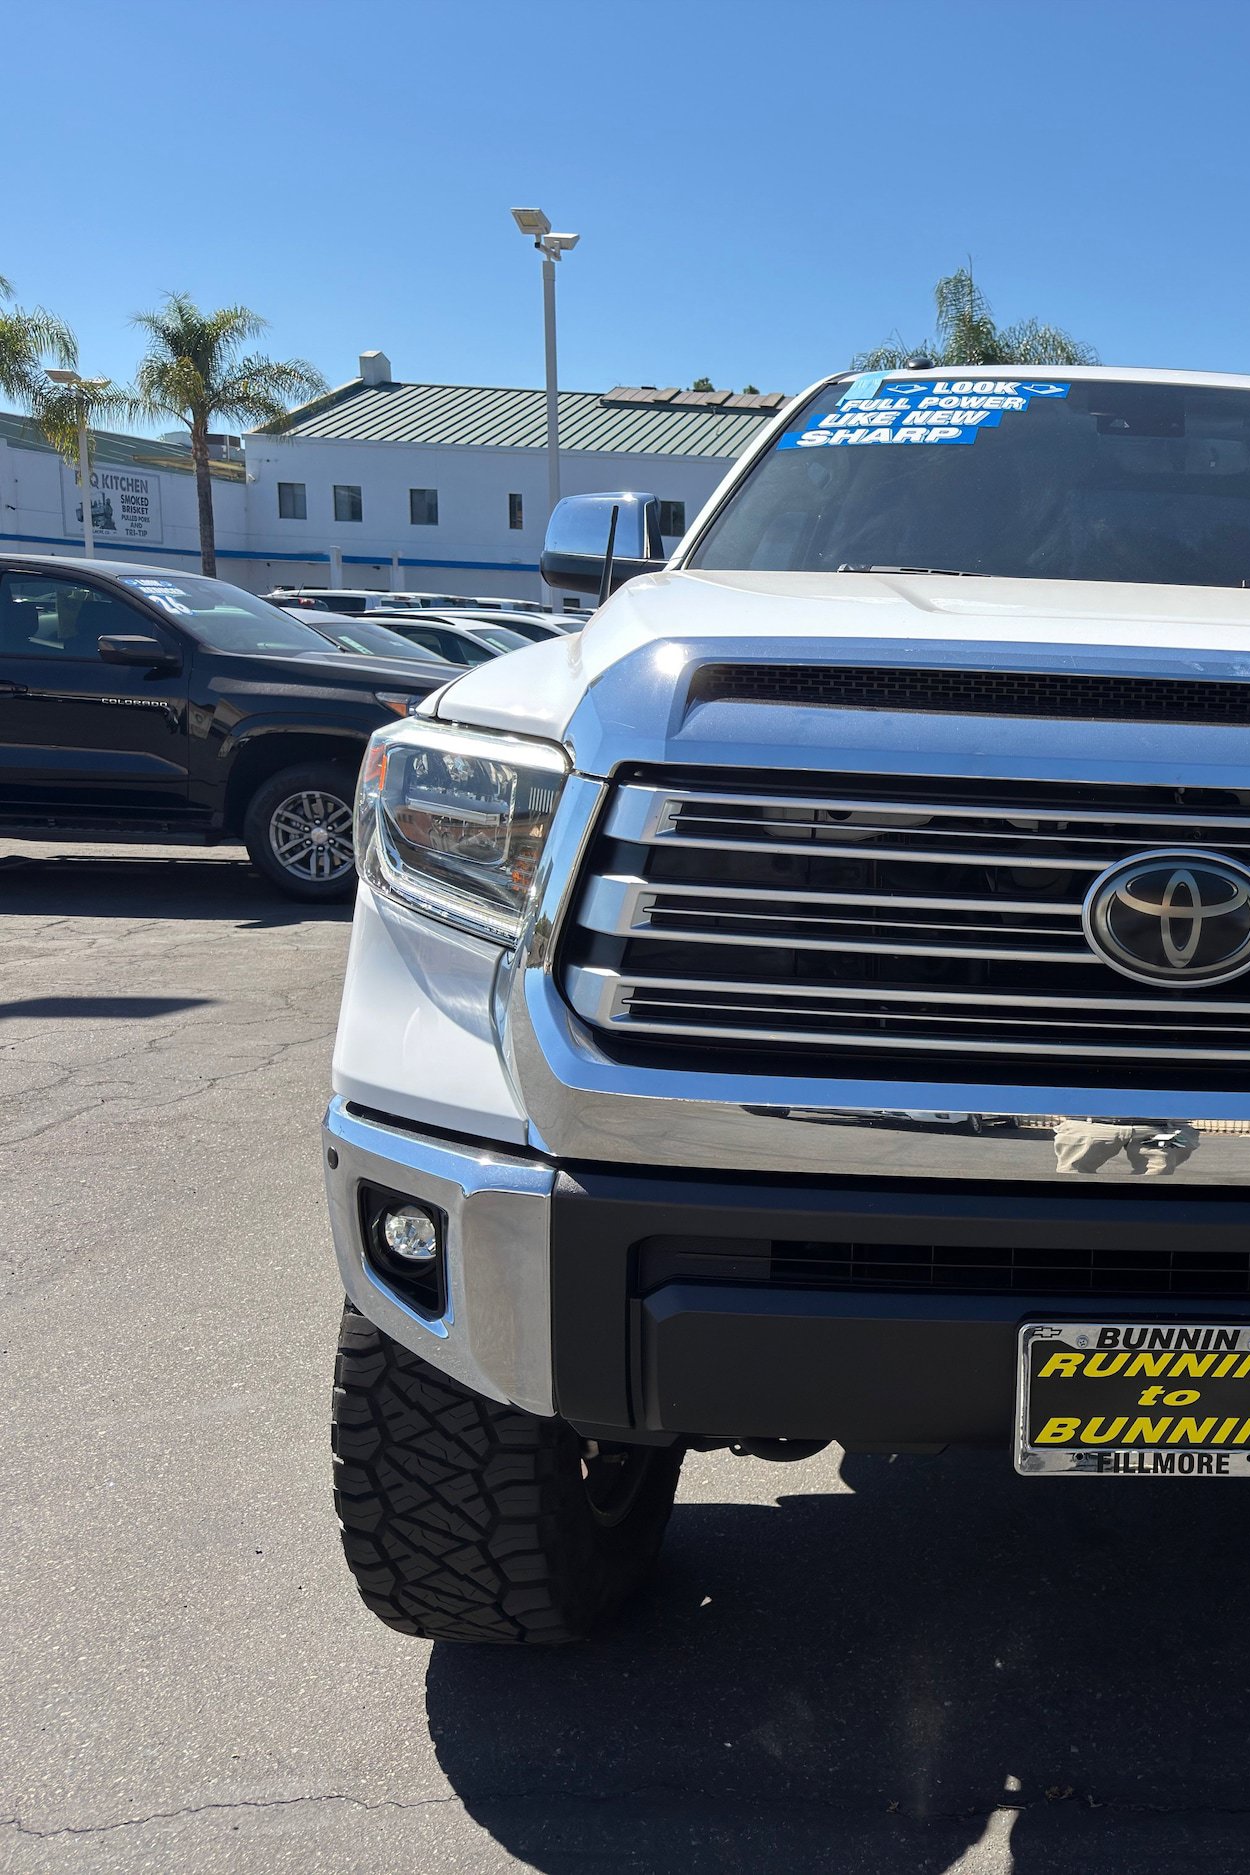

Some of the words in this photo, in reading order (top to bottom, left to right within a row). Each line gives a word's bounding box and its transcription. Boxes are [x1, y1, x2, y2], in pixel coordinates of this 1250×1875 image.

[932, 381, 1021, 396] LOOK
[840, 398, 911, 413] FULL
[919, 396, 1026, 411] POWER
[818, 411, 900, 428] LIKE
[902, 410, 990, 426] NEW
[796, 427, 962, 448] SHARP
[102, 473, 149, 494] KITCHEN
[120, 494, 149, 507] SMOKED
[121, 505, 149, 515] BRISKET
[125, 529, 148, 537] TRI-TIP
[101, 698, 168, 707] COLORADO
[1096, 1327, 1241, 1350] BUNNIN
[1137, 1385, 1201, 1406] to
[1096, 1452, 1230, 1475] FILLMORE
